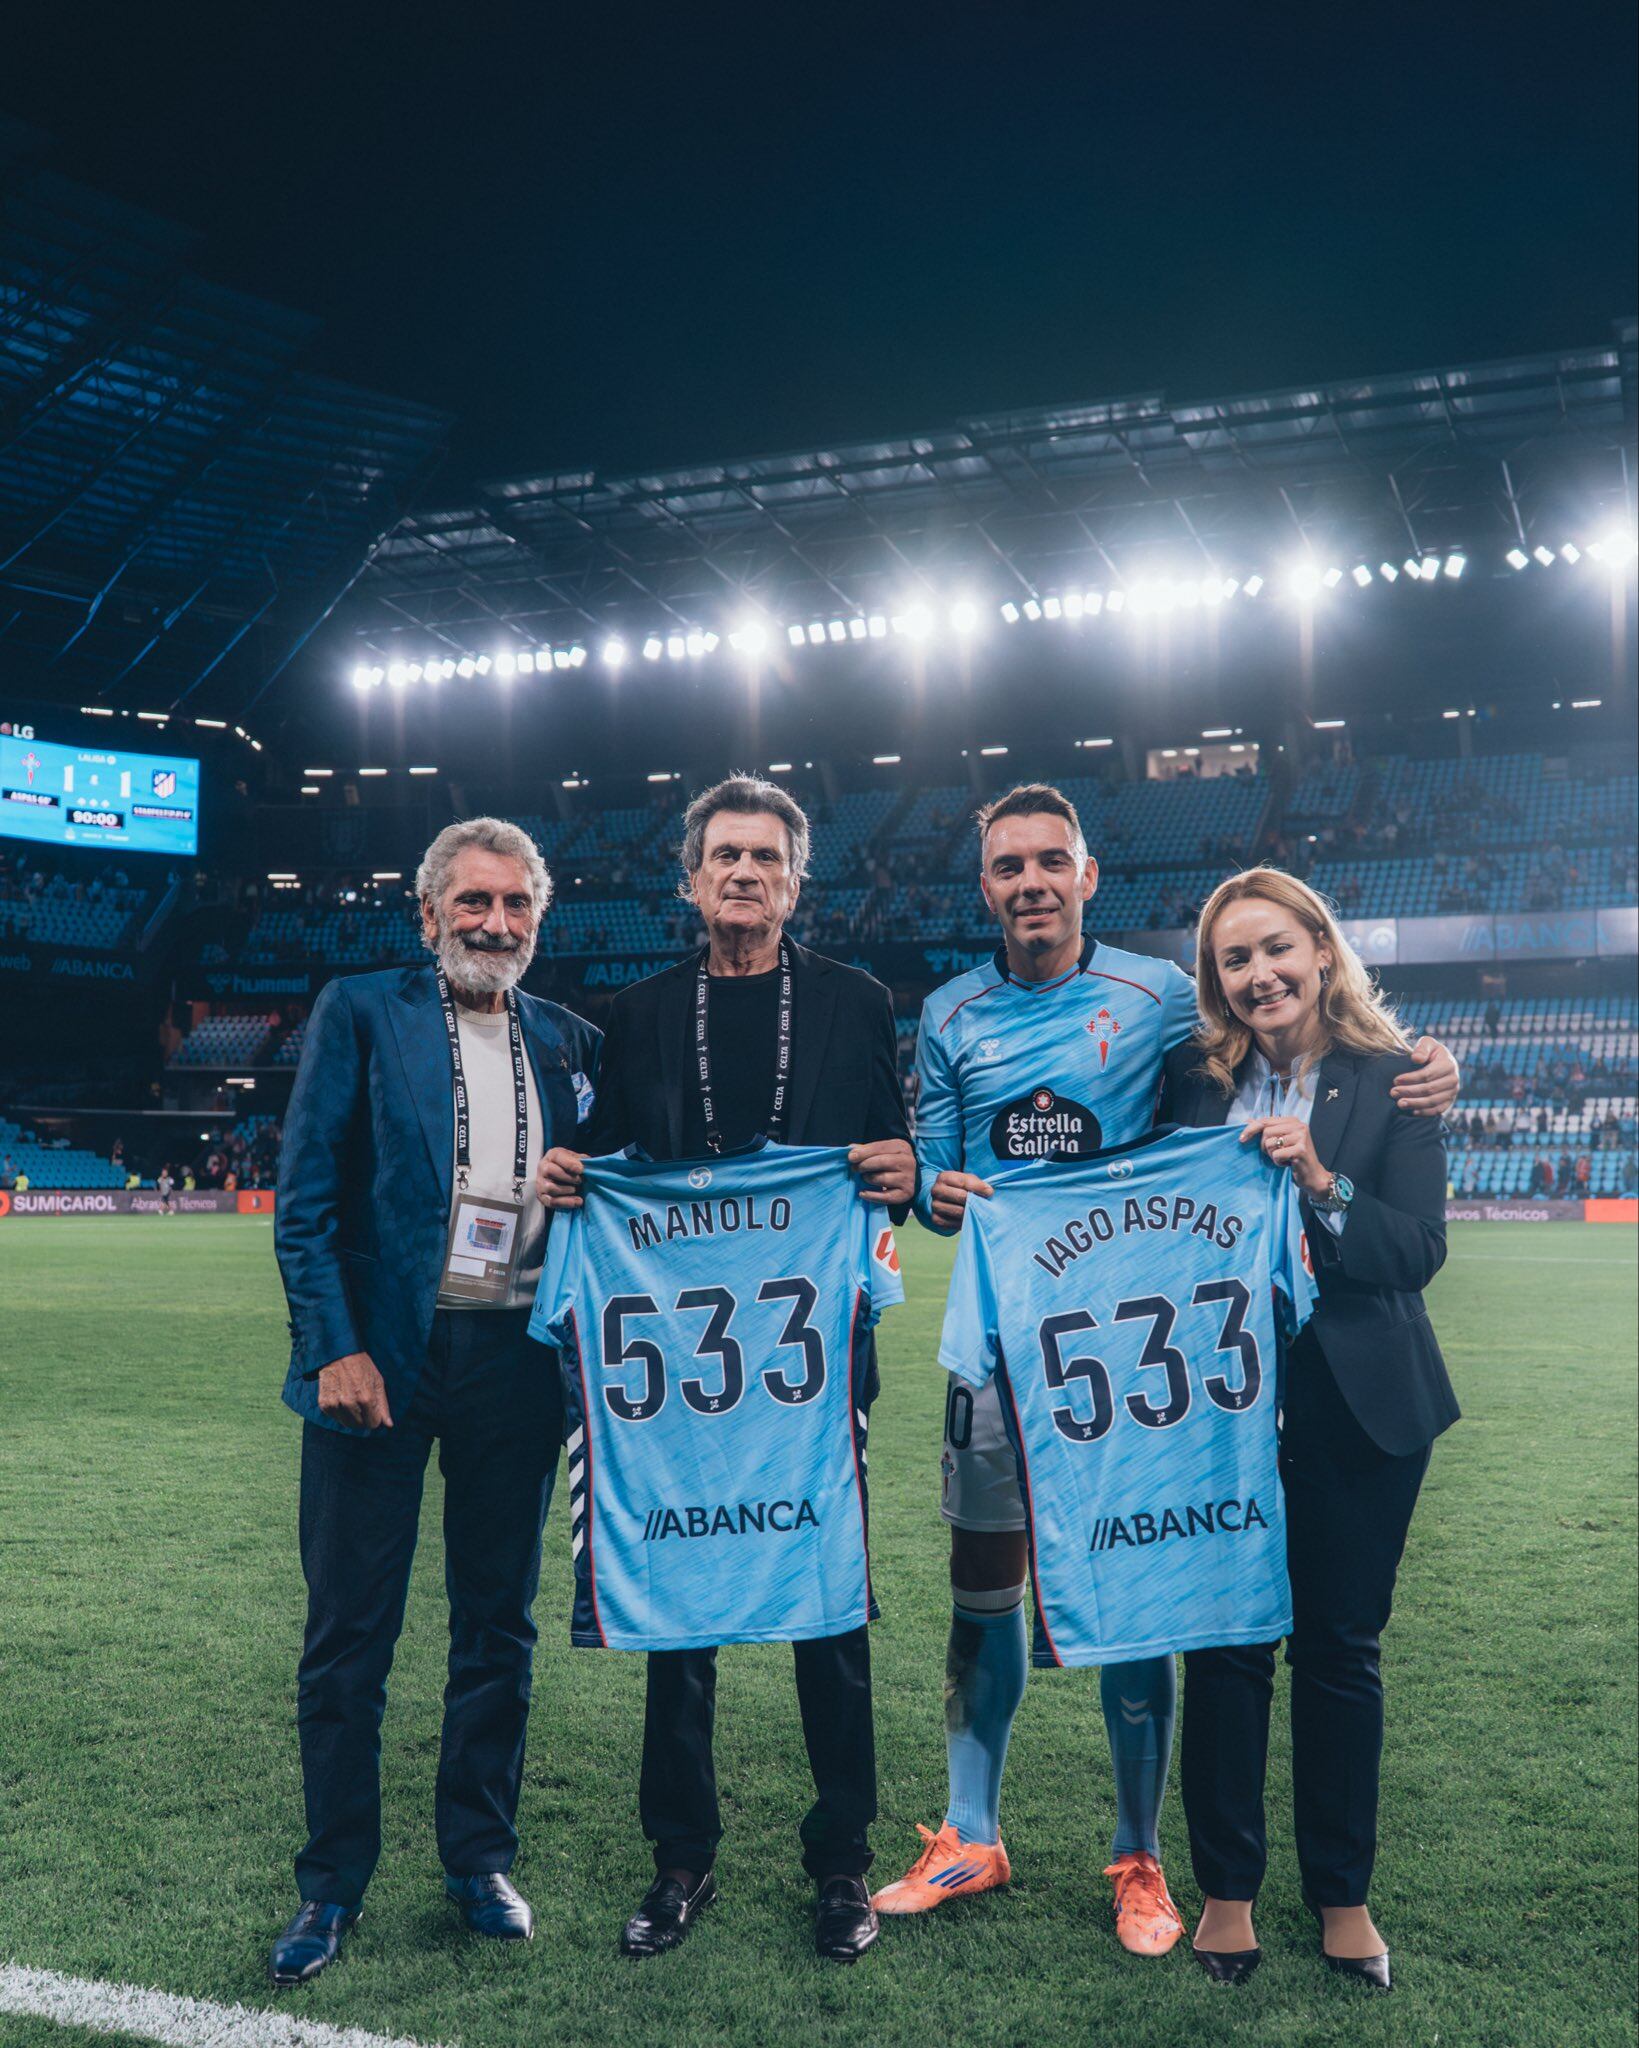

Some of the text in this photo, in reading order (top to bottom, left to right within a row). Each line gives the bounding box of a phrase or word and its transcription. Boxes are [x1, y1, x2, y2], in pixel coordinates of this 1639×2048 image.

[13, 724, 35, 740] LG
[64, 765, 131, 798] 1 1
[73, 811, 118, 826] 90:00
[232, 972, 308, 992] hummel
[782, 975, 791, 995] CELTA
[445, 1012, 455, 1032] CELTA
[781, 1010, 790, 1031] CELTA
[511, 1022, 519, 1042] CELTA
[453, 1048, 461, 1070] CELTA
[697, 983, 713, 1122] CELTA CELTA CELTA CELTA
[780, 1046, 789, 1069] CELTA
[515, 1056, 523, 1077] CELTA
[456, 1085, 465, 1108] CELTA
[774, 1086, 785, 1110] CELTA
[1006, 1112, 1084, 1134] Estrella
[458, 1125, 466, 1149] CELTA
[518, 1130, 526, 1153] CELTA
[627, 1196, 792, 1252] MANOLO
[1485, 1206, 1549, 1221] Técnicos
[1033, 1195, 1245, 1279] IAGO ASPAS
[602, 1276, 828, 1422] 533
[1038, 1276, 1262, 1444] 533
